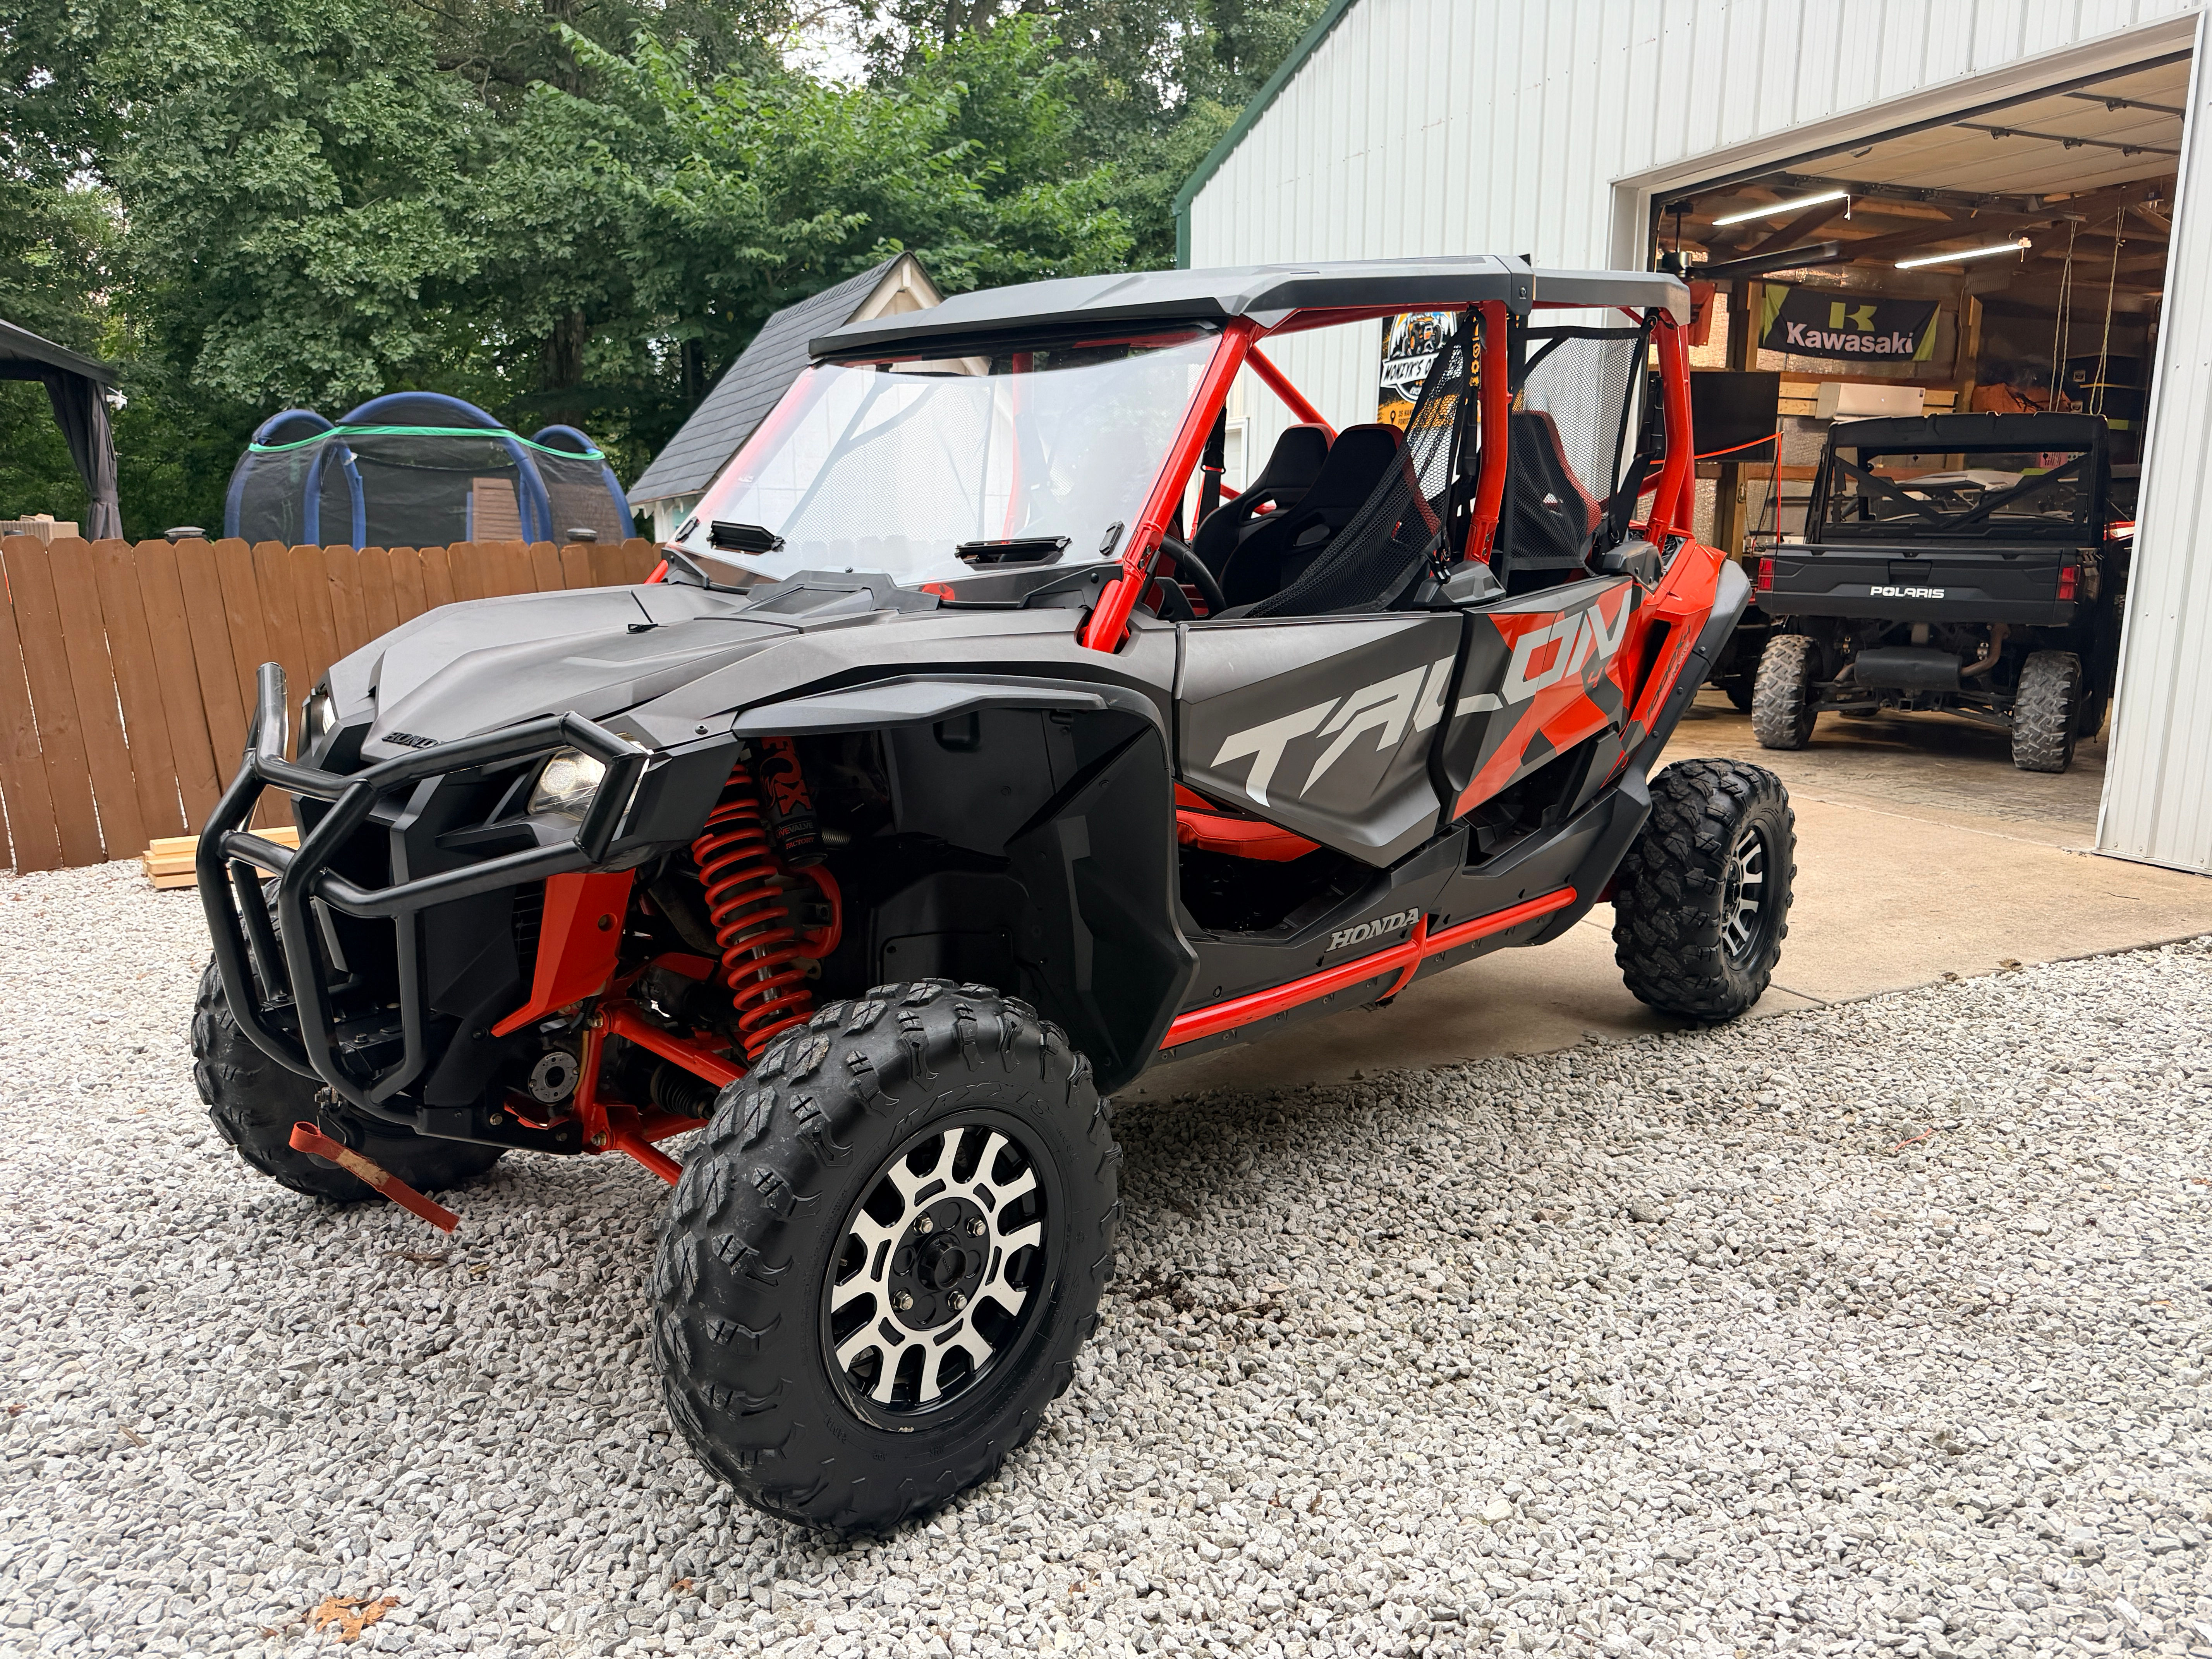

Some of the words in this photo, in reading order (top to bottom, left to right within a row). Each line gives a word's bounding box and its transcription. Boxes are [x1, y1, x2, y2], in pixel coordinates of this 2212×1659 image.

[1829, 301, 1877, 332] K
[1786, 321, 1913, 354] Kawasaki
[1870, 586, 1945, 599] POLARIS
[1210, 588, 1633, 807] TALON
[381, 731, 447, 749] HOND
[760, 736, 812, 815] FOX
[786, 836, 814, 850] FACTORY
[1325, 907, 1420, 953] HONDA
